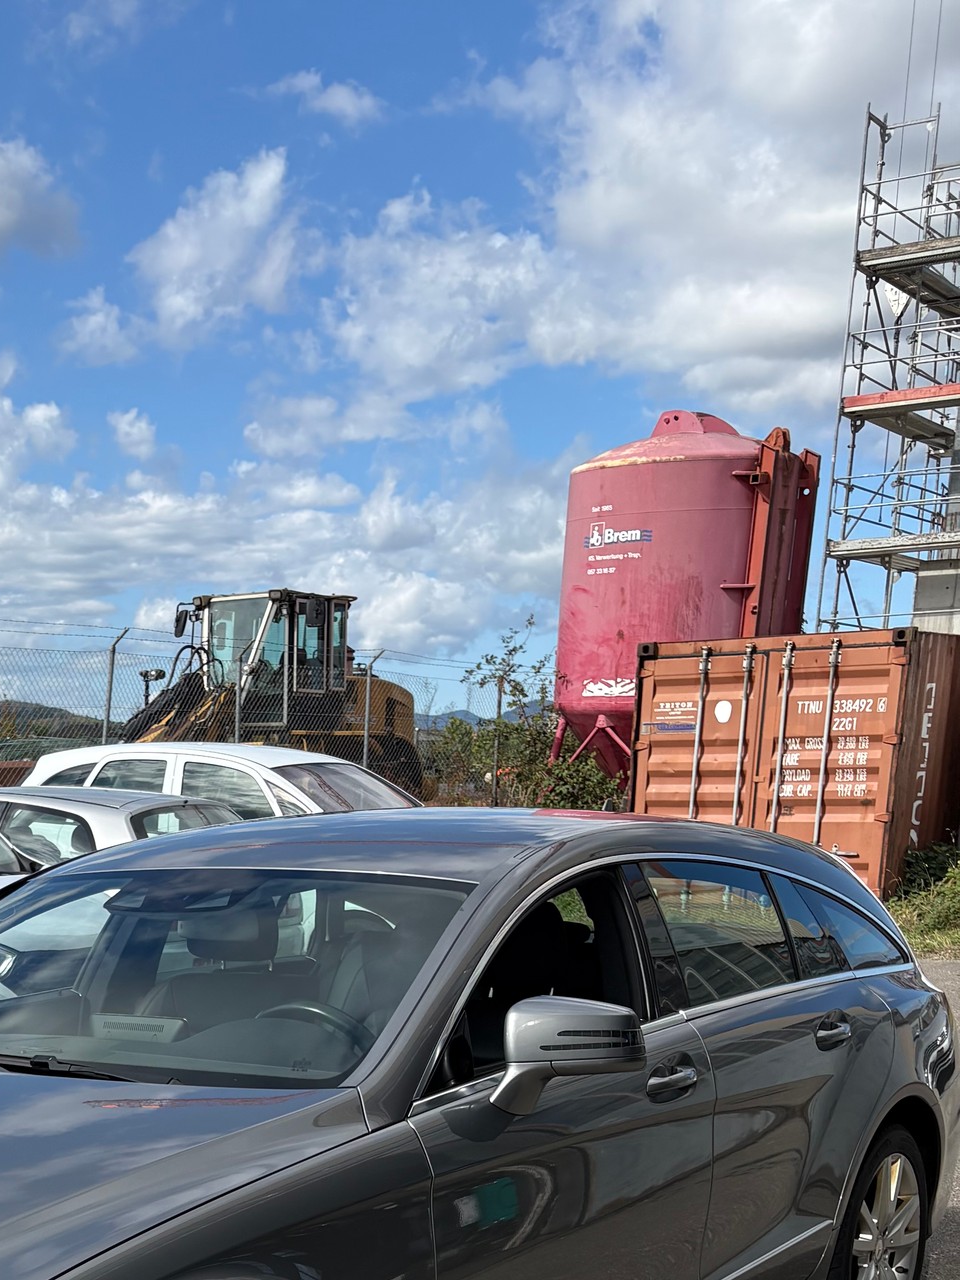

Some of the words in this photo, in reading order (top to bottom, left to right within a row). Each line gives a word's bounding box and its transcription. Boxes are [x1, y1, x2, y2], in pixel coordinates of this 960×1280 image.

[604, 528, 641, 544] Brem
[659, 701, 693, 709] TRITON
[797, 701, 823, 714] TTNU
[833, 699, 874, 713] 338492
[878, 698, 887, 712] 6
[832, 718, 857, 731] 22G1
[782, 753, 800, 766] TARE
[781, 769, 811, 781] PAYLOAD
